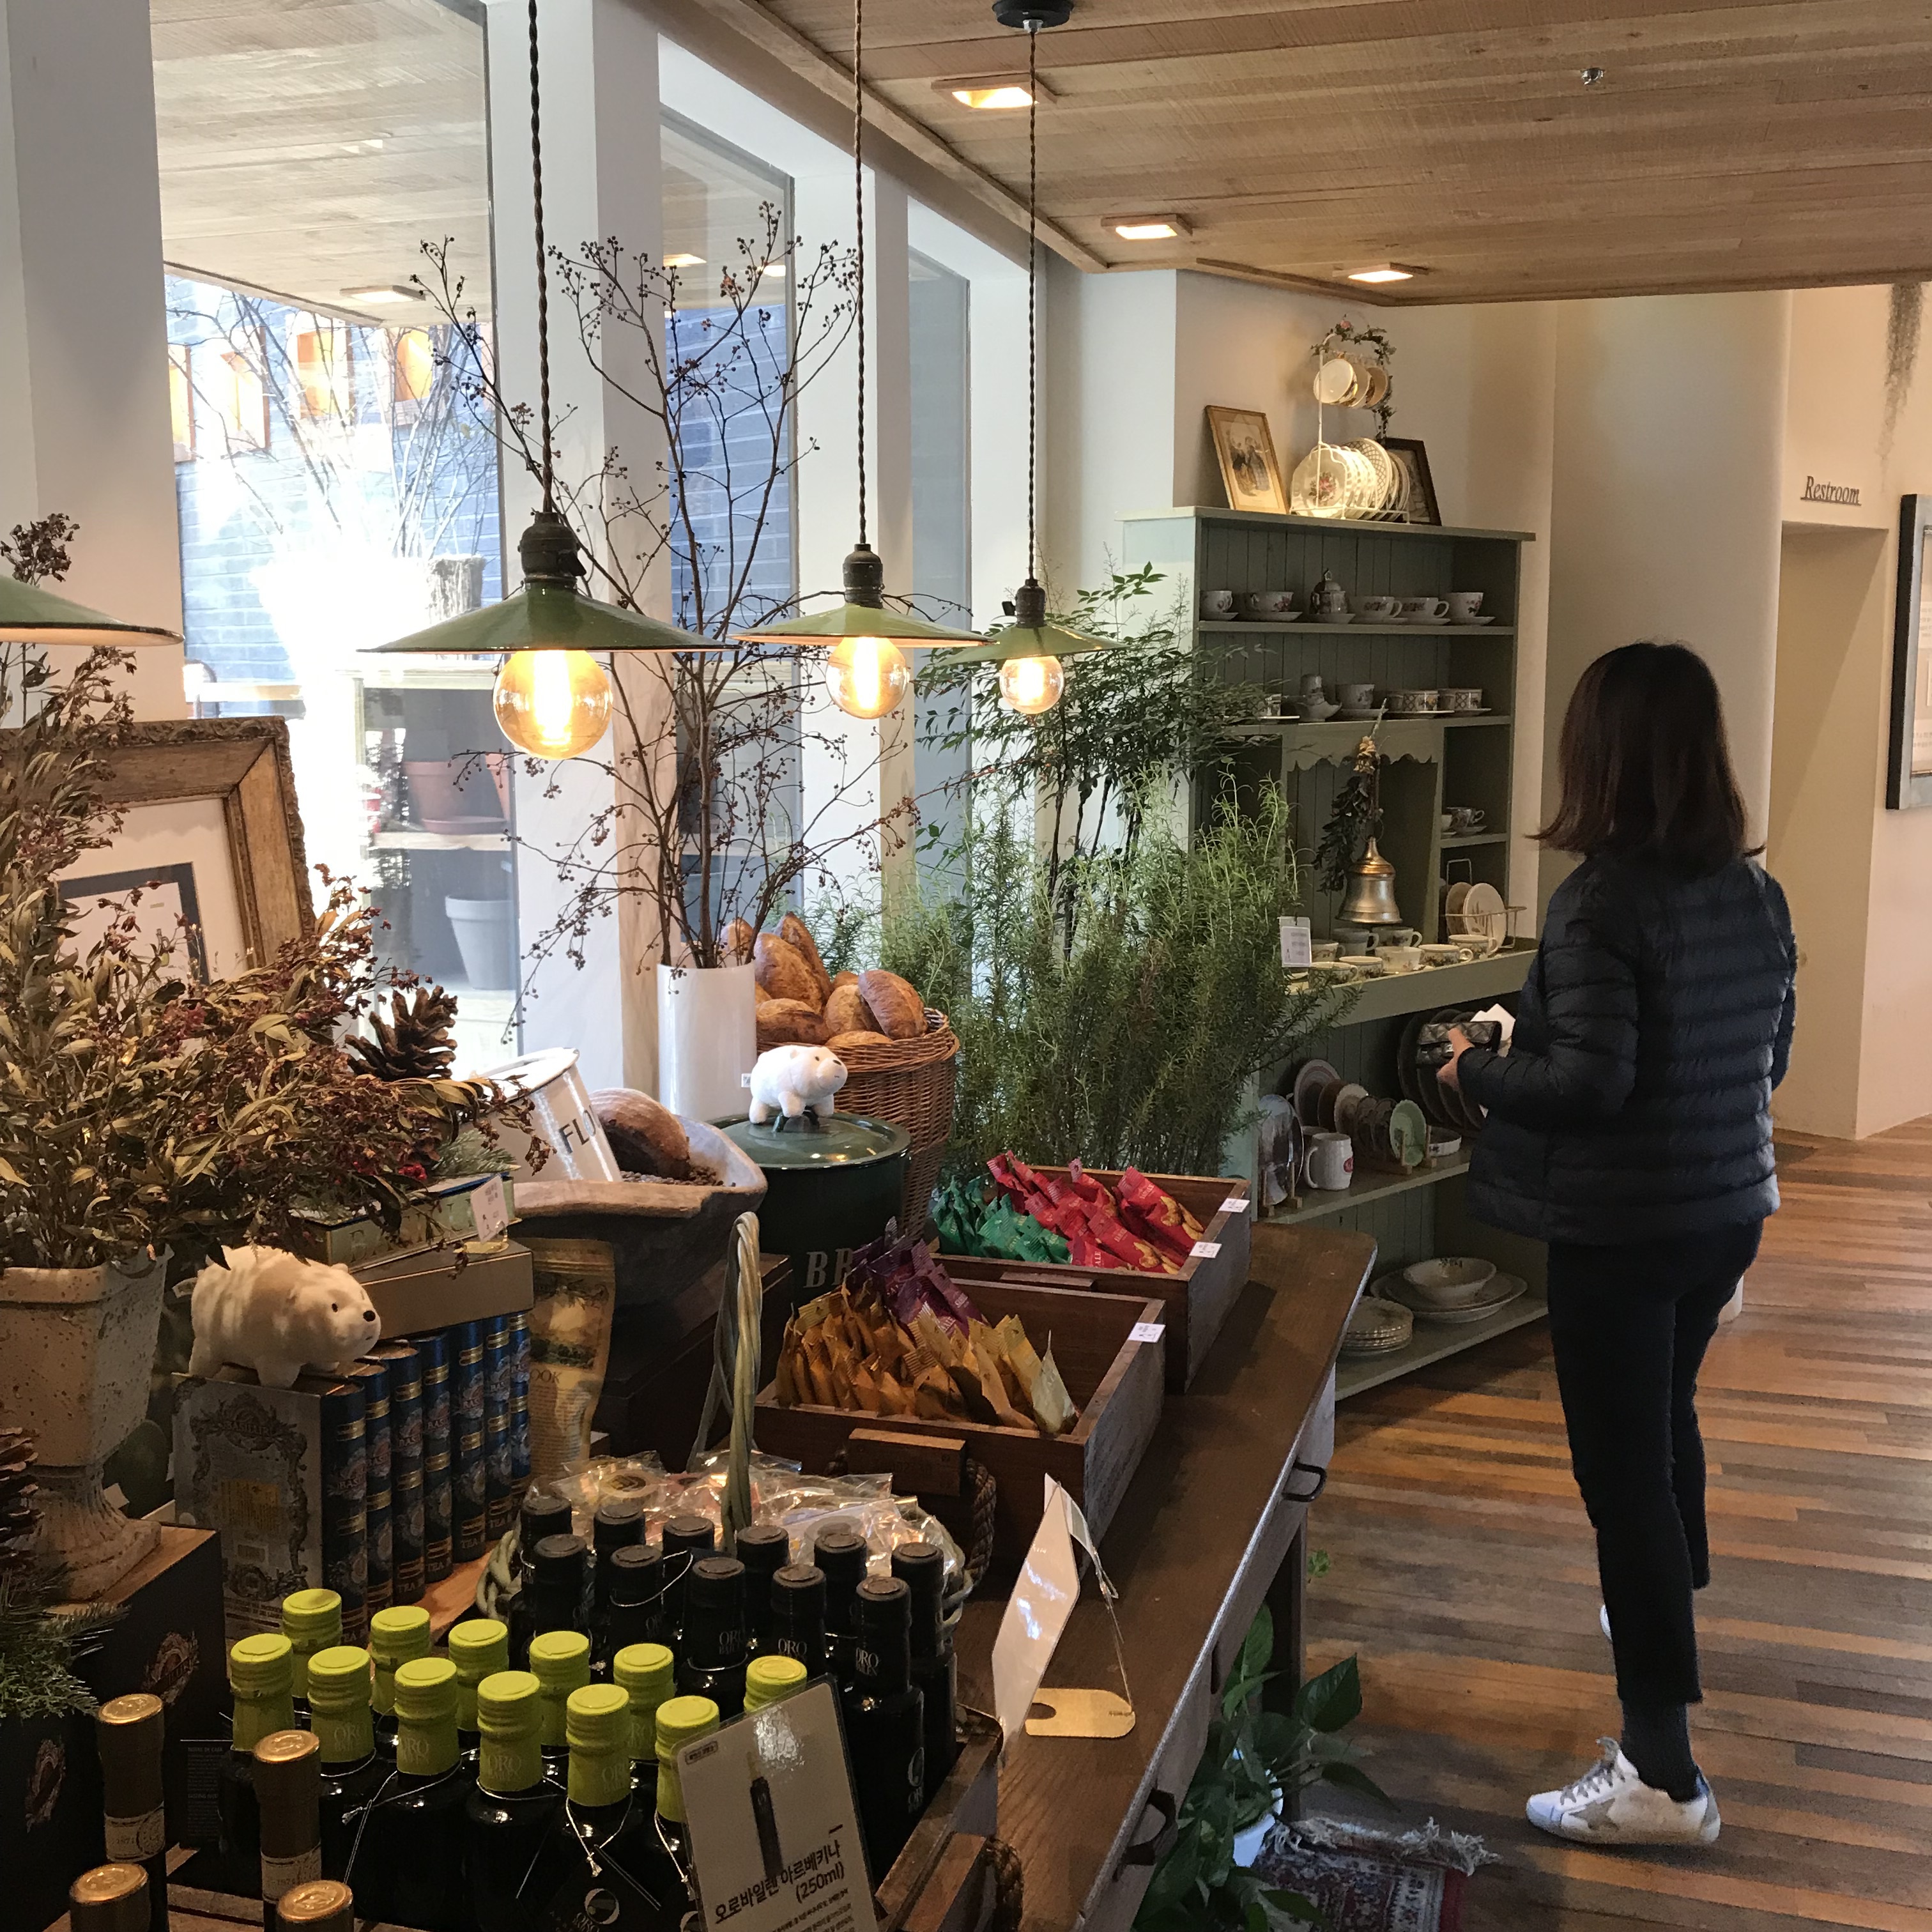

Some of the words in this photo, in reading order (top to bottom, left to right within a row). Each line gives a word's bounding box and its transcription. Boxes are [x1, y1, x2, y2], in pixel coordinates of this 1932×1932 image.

[1804, 475, 1861, 505] Restroom
[778, 1638, 808, 1660] ORO
[715, 1873, 779, 1925] 오로바일렌
[780, 1839, 841, 1886] 아르베키나
[795, 1860, 845, 1905] (250ml)
